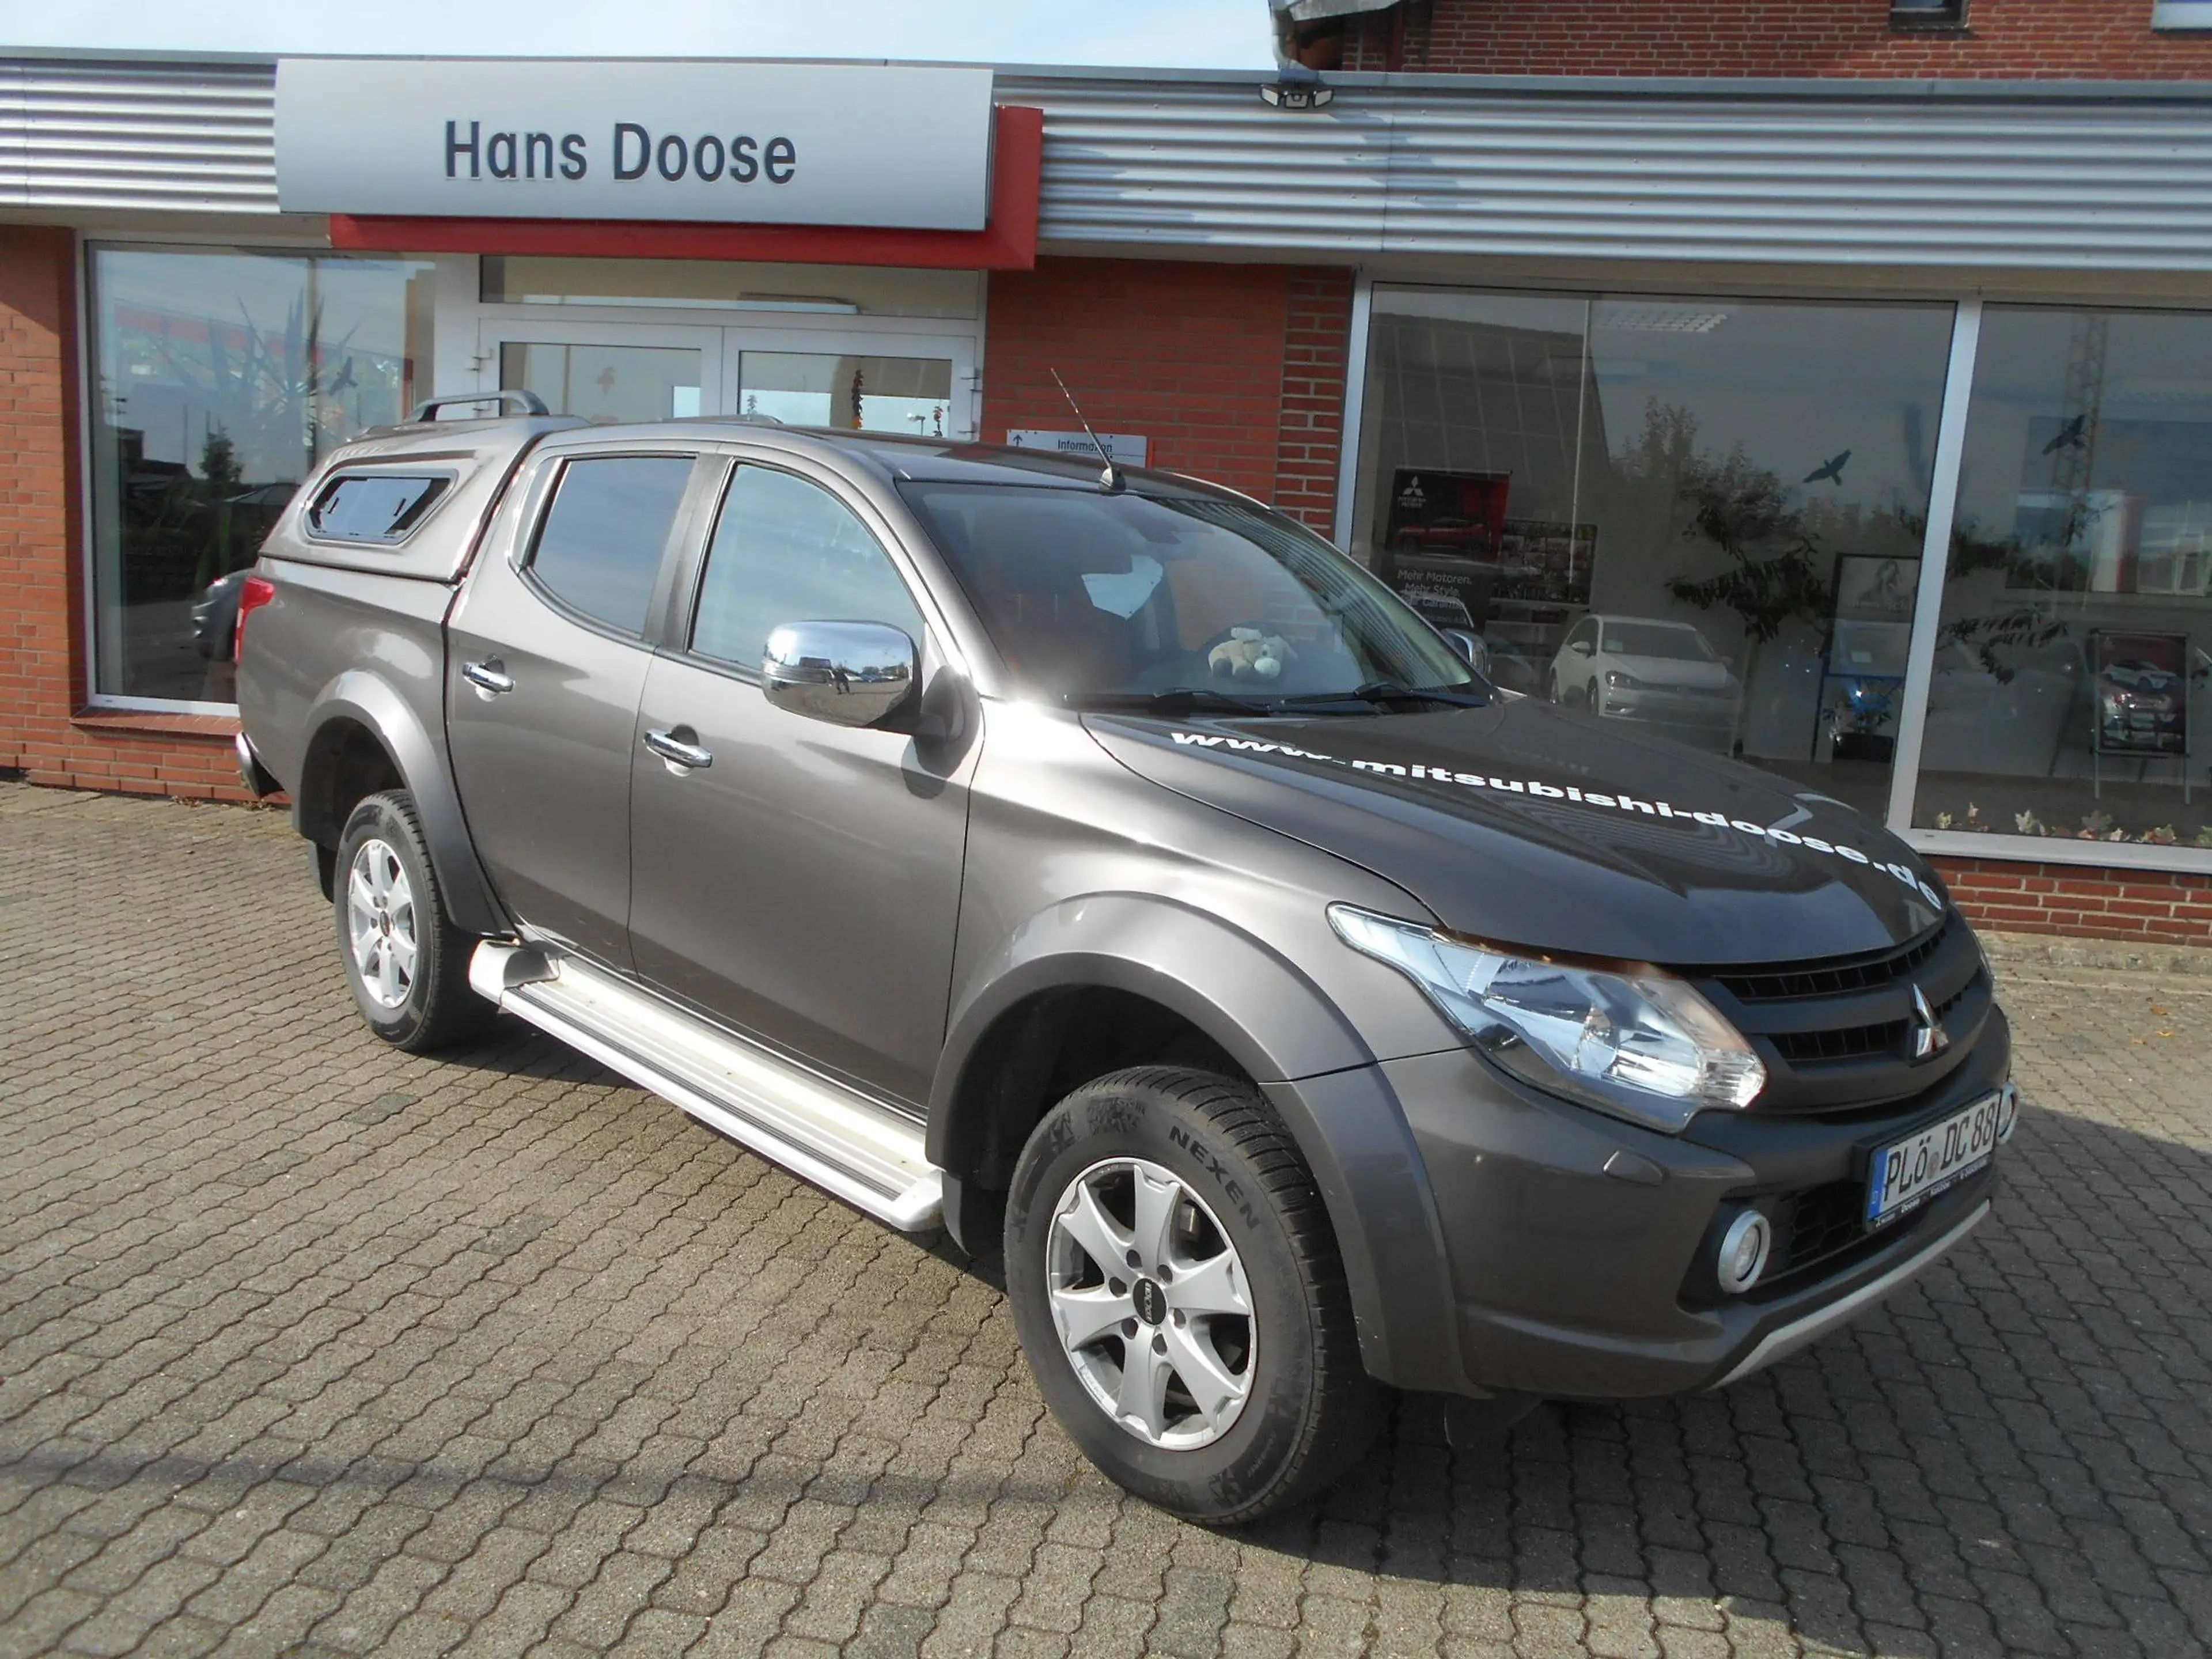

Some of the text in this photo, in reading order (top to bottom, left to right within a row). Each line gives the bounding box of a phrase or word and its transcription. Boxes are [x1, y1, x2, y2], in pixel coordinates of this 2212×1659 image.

[446, 120, 797, 185] Hans Doose
[1168, 1125, 1260, 1230] NEXEN
